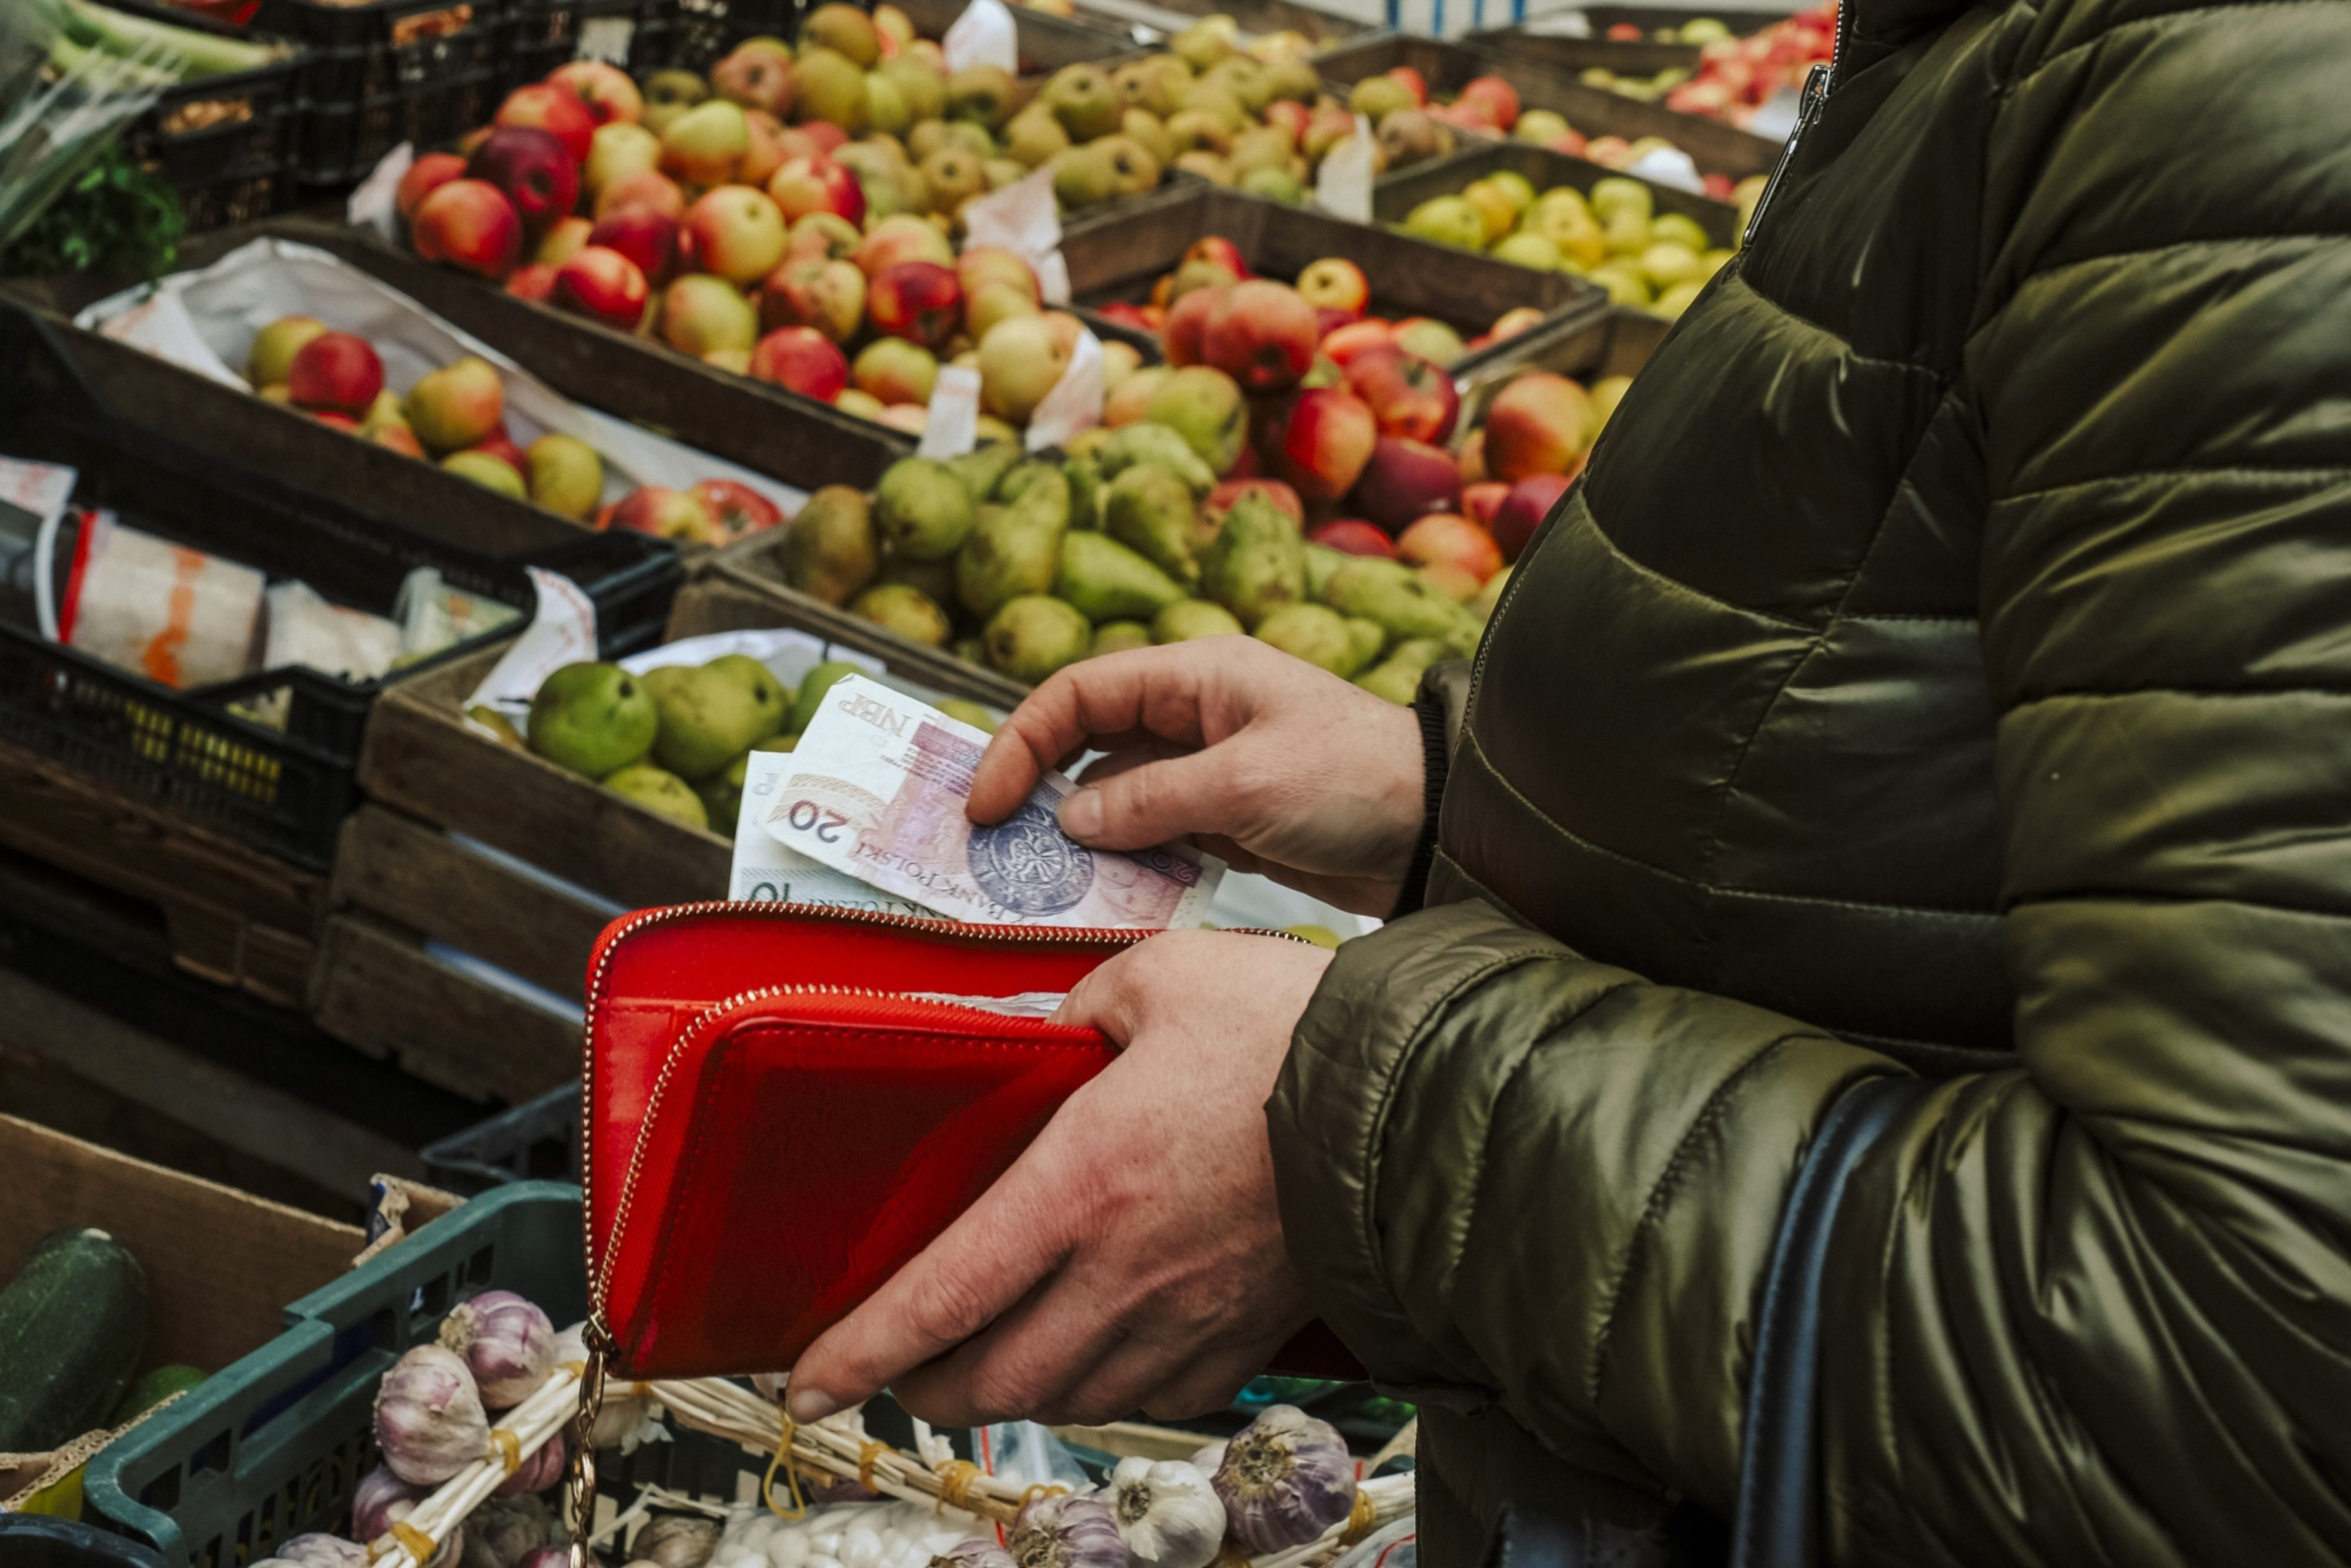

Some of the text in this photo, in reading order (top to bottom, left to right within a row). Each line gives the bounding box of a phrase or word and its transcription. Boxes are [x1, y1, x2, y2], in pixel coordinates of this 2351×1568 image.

[838, 693, 913, 737] NBP
[789, 800, 849, 843] 20
[855, 843, 942, 887] POLSKI
[1152, 852, 1195, 882] 20
